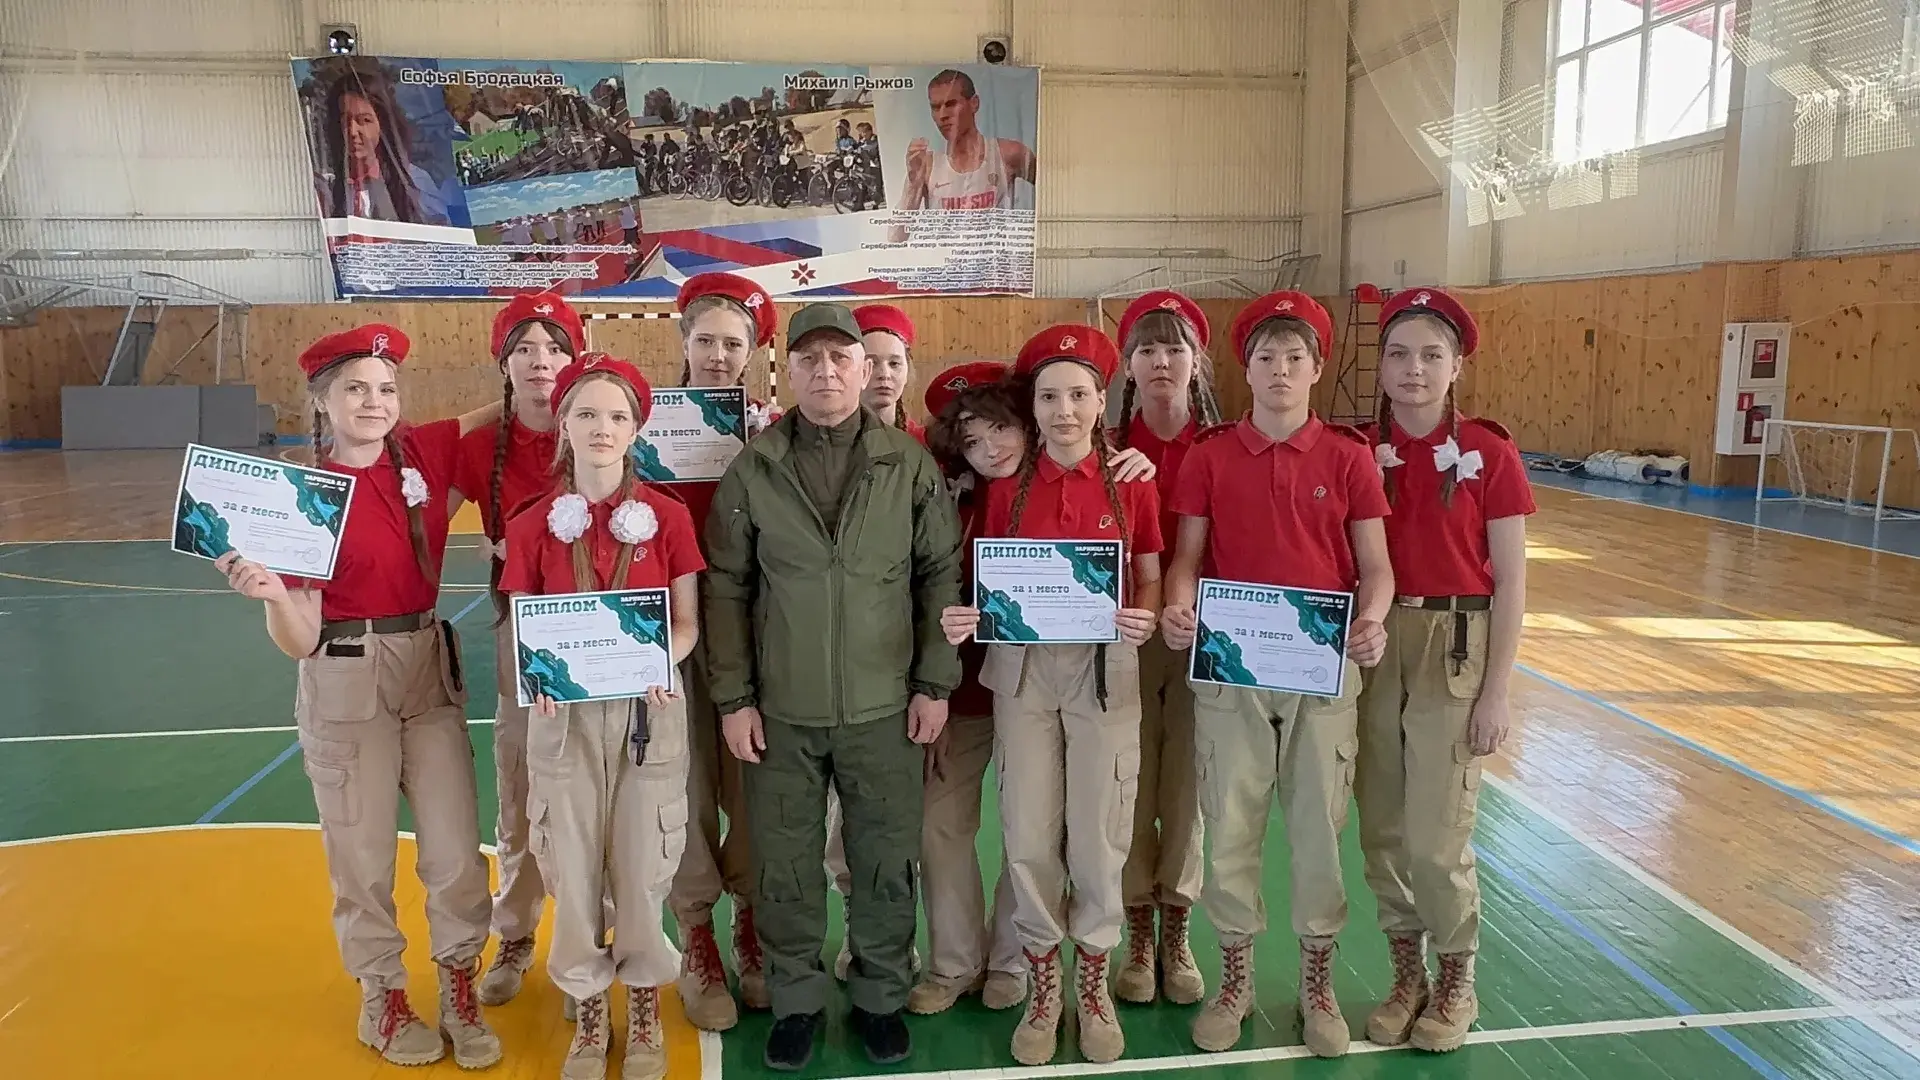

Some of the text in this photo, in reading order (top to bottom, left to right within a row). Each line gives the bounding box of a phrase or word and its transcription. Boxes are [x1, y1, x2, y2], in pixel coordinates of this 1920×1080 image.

[401, 69, 564, 86] Софья Бродацкая
[784, 75, 914, 89] Михаил Рыжов
[860, 242, 908, 250] Серебряный
[651, 395, 684, 405] ЛОМ
[193, 454, 280, 481] ДИПЛОМ
[240, 504, 248, 513] 2
[982, 547, 1052, 559] ДИПЛОМ
[1206, 586, 1280, 604] ДИПЛОМ
[522, 600, 597, 618] ДИПЛОМ
